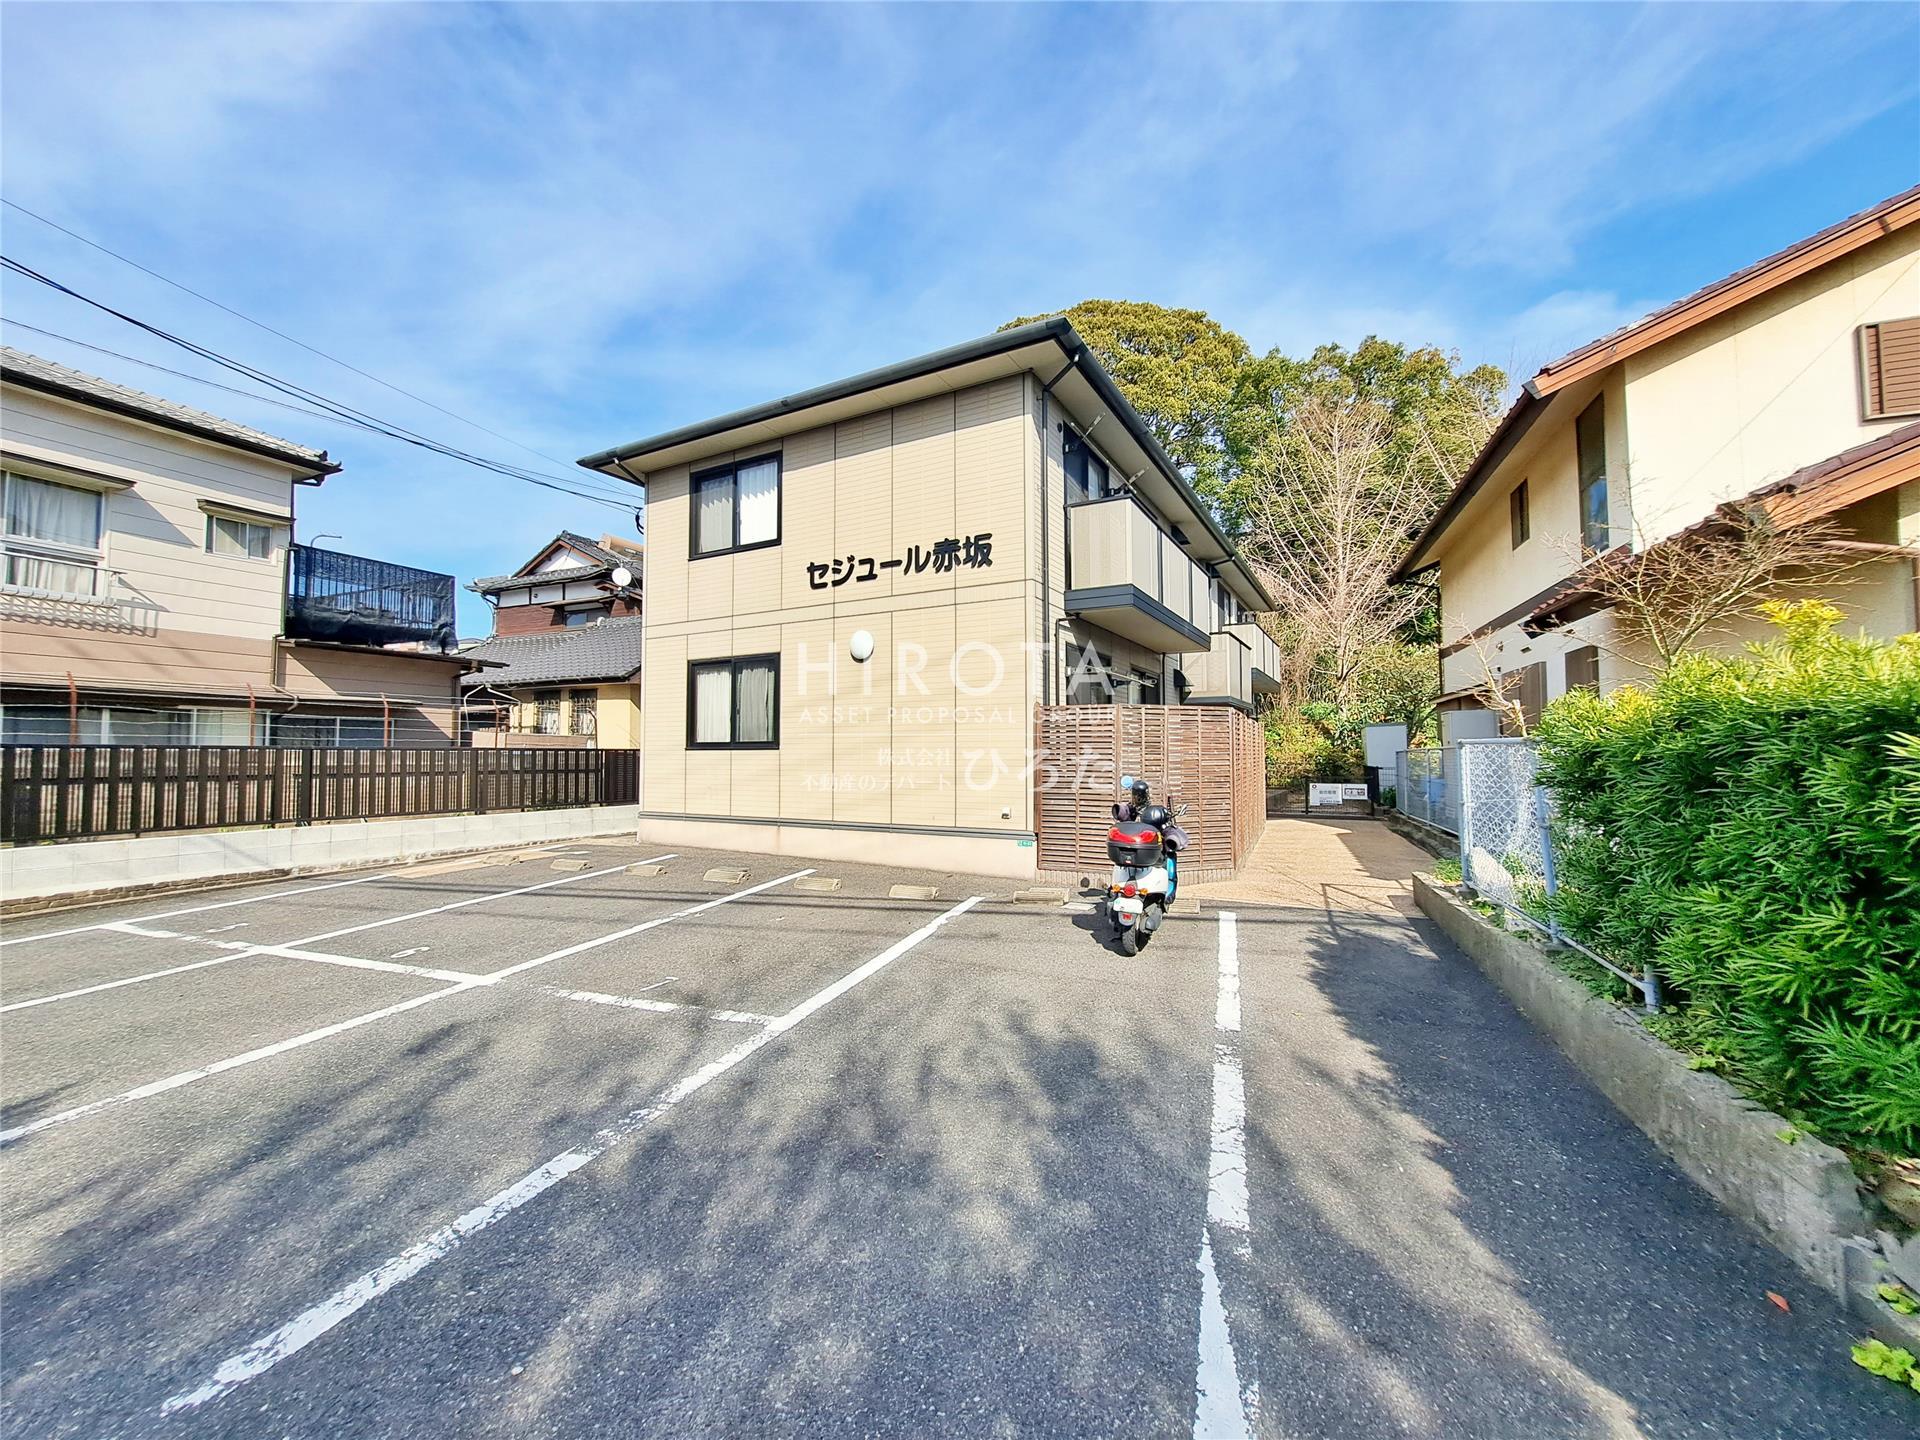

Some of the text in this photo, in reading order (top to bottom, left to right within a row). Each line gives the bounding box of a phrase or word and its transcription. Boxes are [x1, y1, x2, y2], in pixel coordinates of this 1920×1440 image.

[806, 532, 993, 590] セジュール赤坂
[390, 946, 430, 959] 6
